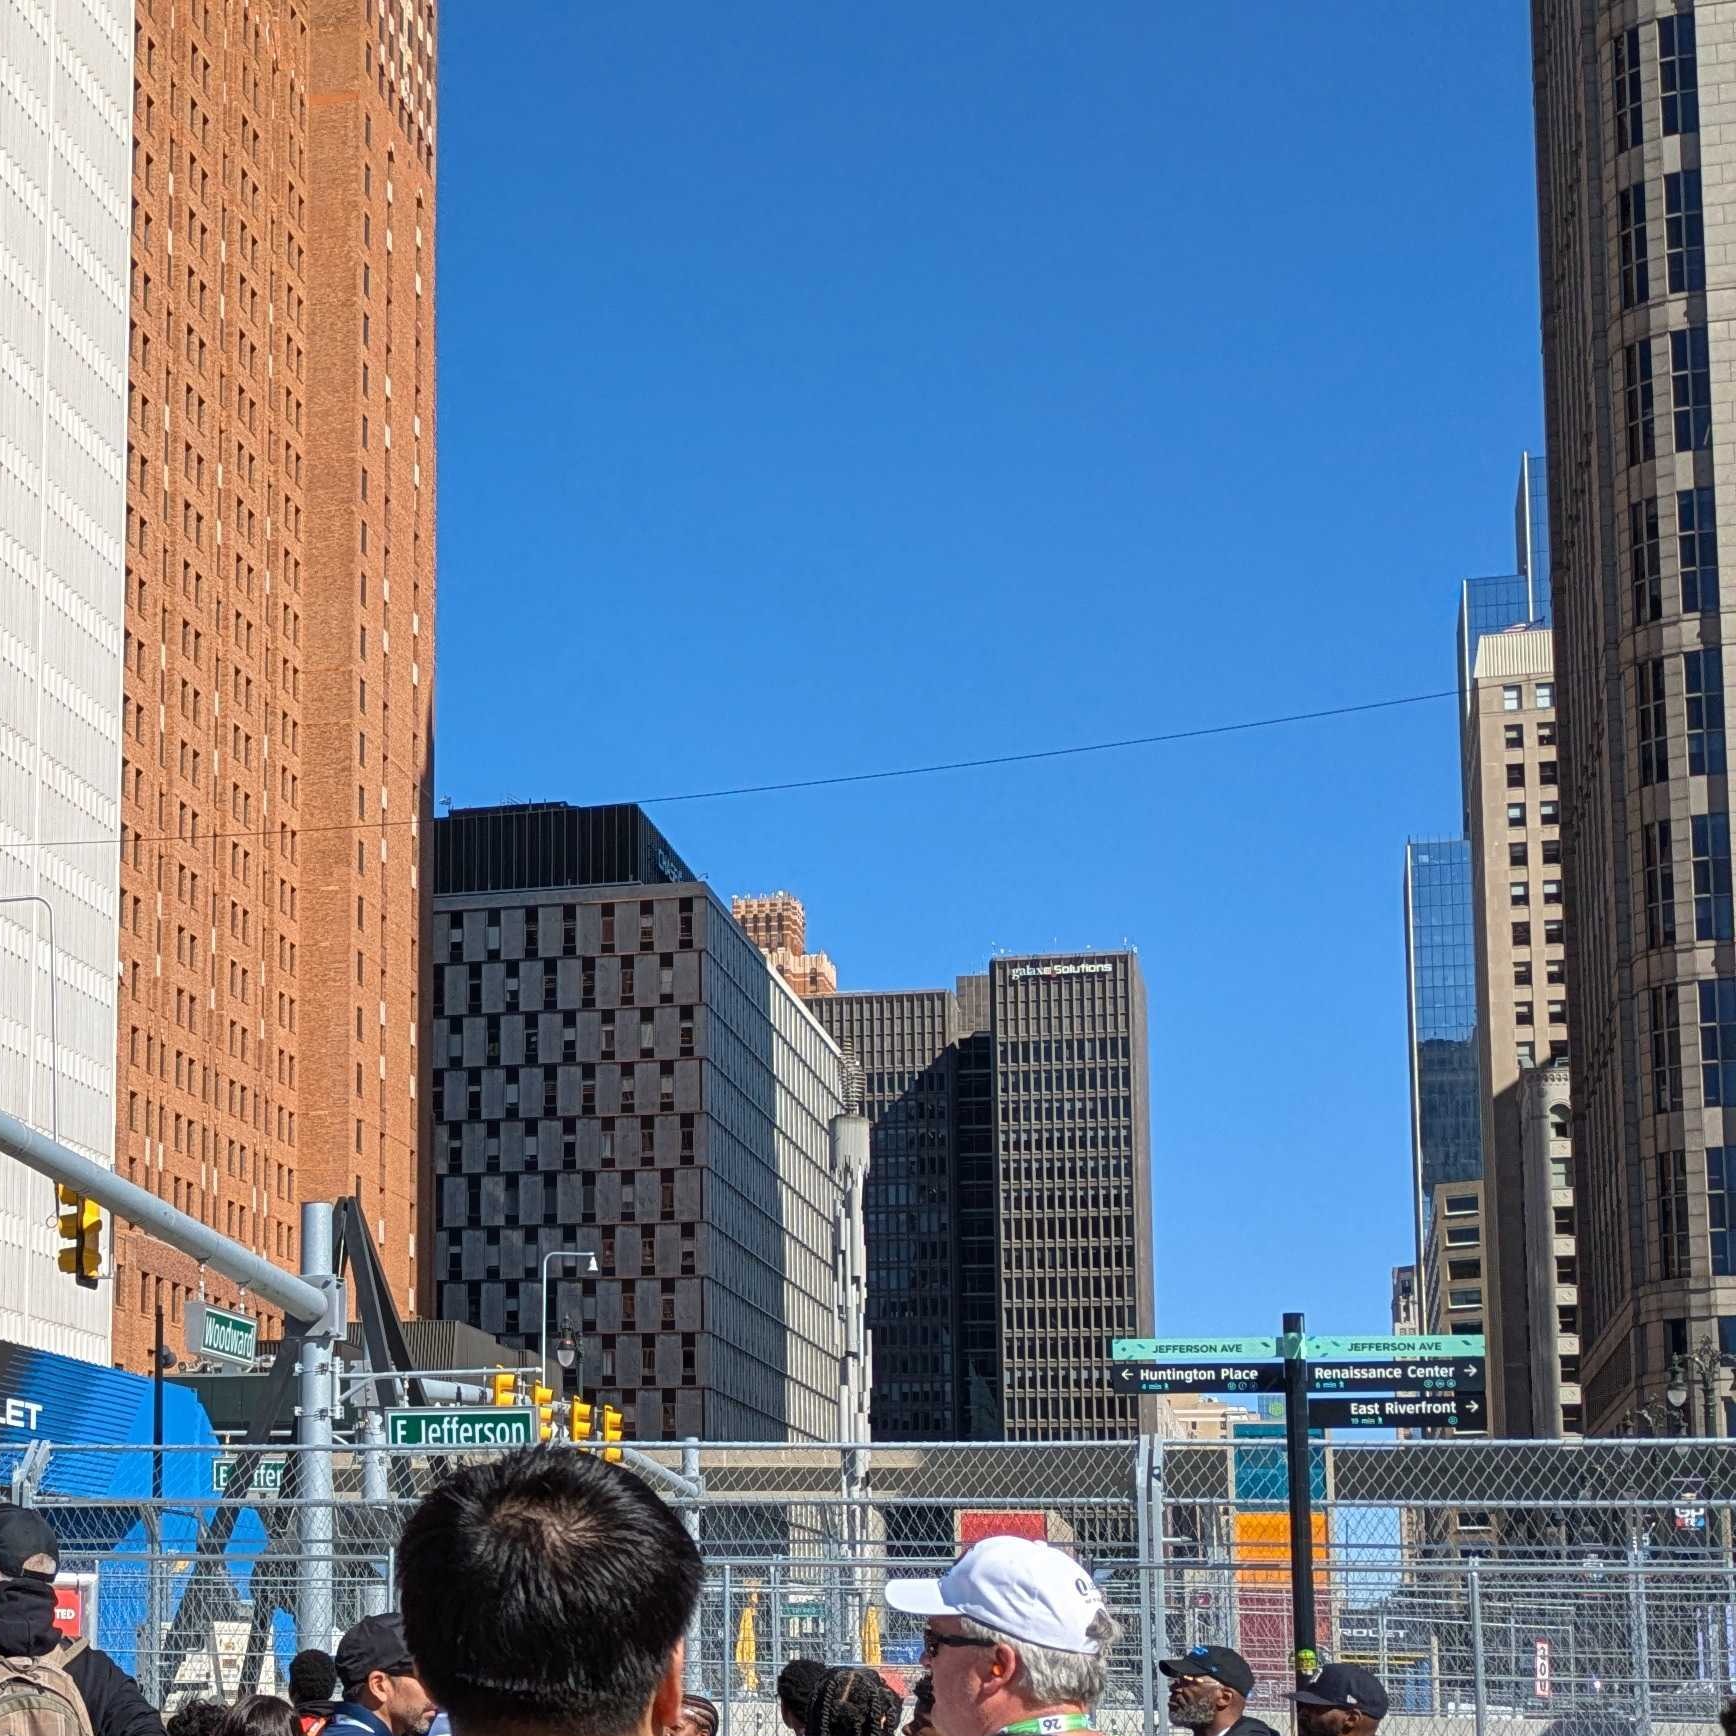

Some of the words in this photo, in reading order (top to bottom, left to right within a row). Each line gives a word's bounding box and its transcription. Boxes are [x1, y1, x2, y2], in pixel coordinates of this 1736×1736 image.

[204, 1315, 254, 1359] Woodward
[1152, 1344, 1218, 1354] JEFFERSON
[1220, 1343, 1243, 1353] AVE
[1347, 1342, 1414, 1352] JEFFERSON
[1419, 1342, 1443, 1351] AVE
[1140, 1367, 1216, 1383] Huntington
[1220, 1367, 1259, 1380] Place
[1314, 1365, 1402, 1379] Renaissance
[1407, 1365, 1456, 1379] Center
[1350, 1402, 1380, 1415] East
[1385, 1401, 1457, 1415] Riverfront
[419, 1416, 526, 1444] Jefferson
[54, 1608, 76, 1620] TED
